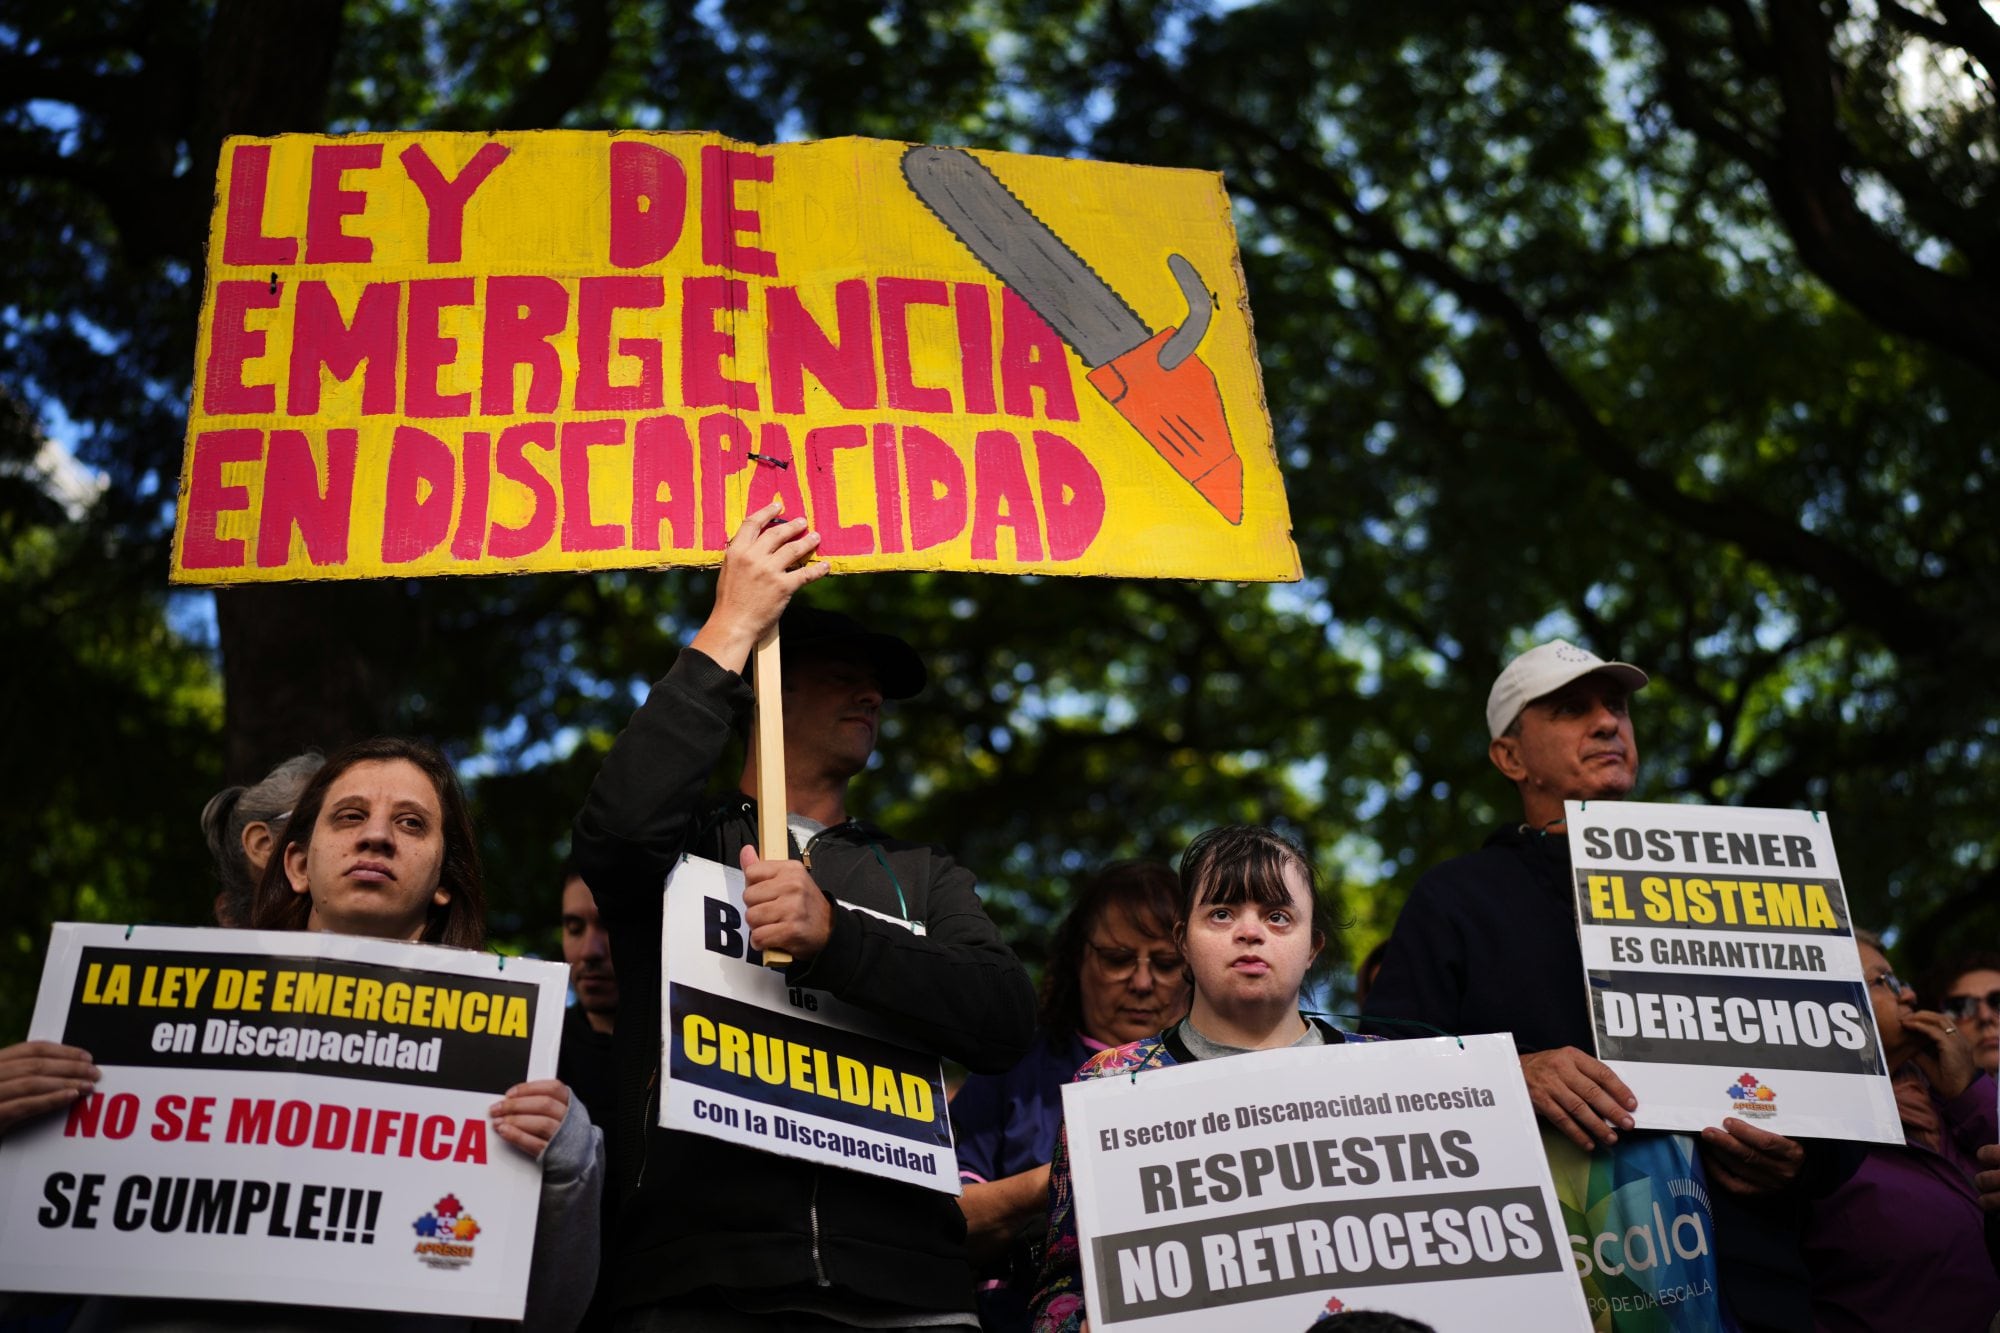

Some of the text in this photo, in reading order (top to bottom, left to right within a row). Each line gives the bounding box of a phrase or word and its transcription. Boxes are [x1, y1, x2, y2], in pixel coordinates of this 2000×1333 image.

[223, 141, 778, 277] LEY DE
[204, 275, 1080, 422] EMERGENCIA
[182, 412, 1105, 570] EN DISCAPACIDAD
[1583, 826, 1817, 868] SOSTENER
[1587, 875, 1839, 929] EL SISTEMA
[1610, 936, 1827, 972] ES GARANTIZAR
[82, 963, 529, 1038] LA LEY DE EMERGENCIA
[789, 986, 818, 1012] de
[1601, 991, 1867, 1050] DERECHOS
[151, 1018, 443, 1073] en Discapacidad
[682, 1014, 935, 1123] CRUELDAD
[63, 1092, 489, 1166] NO SE MODIFICA
[693, 1099, 937, 1176] con la Discapacidad
[1099, 1086, 1496, 1152] El sector de Discapacidad necesita
[37, 1171, 384, 1245] SE CUMPLE!!!
[1138, 1129, 1480, 1215] RESPUESTAS
[1117, 1202, 1543, 1305] NO RETROCESOS
[1567, 1201, 1709, 1279] scala
[1612, 1297, 1632, 1312] DE
[1659, 1278, 1713, 1306] ESCALA
